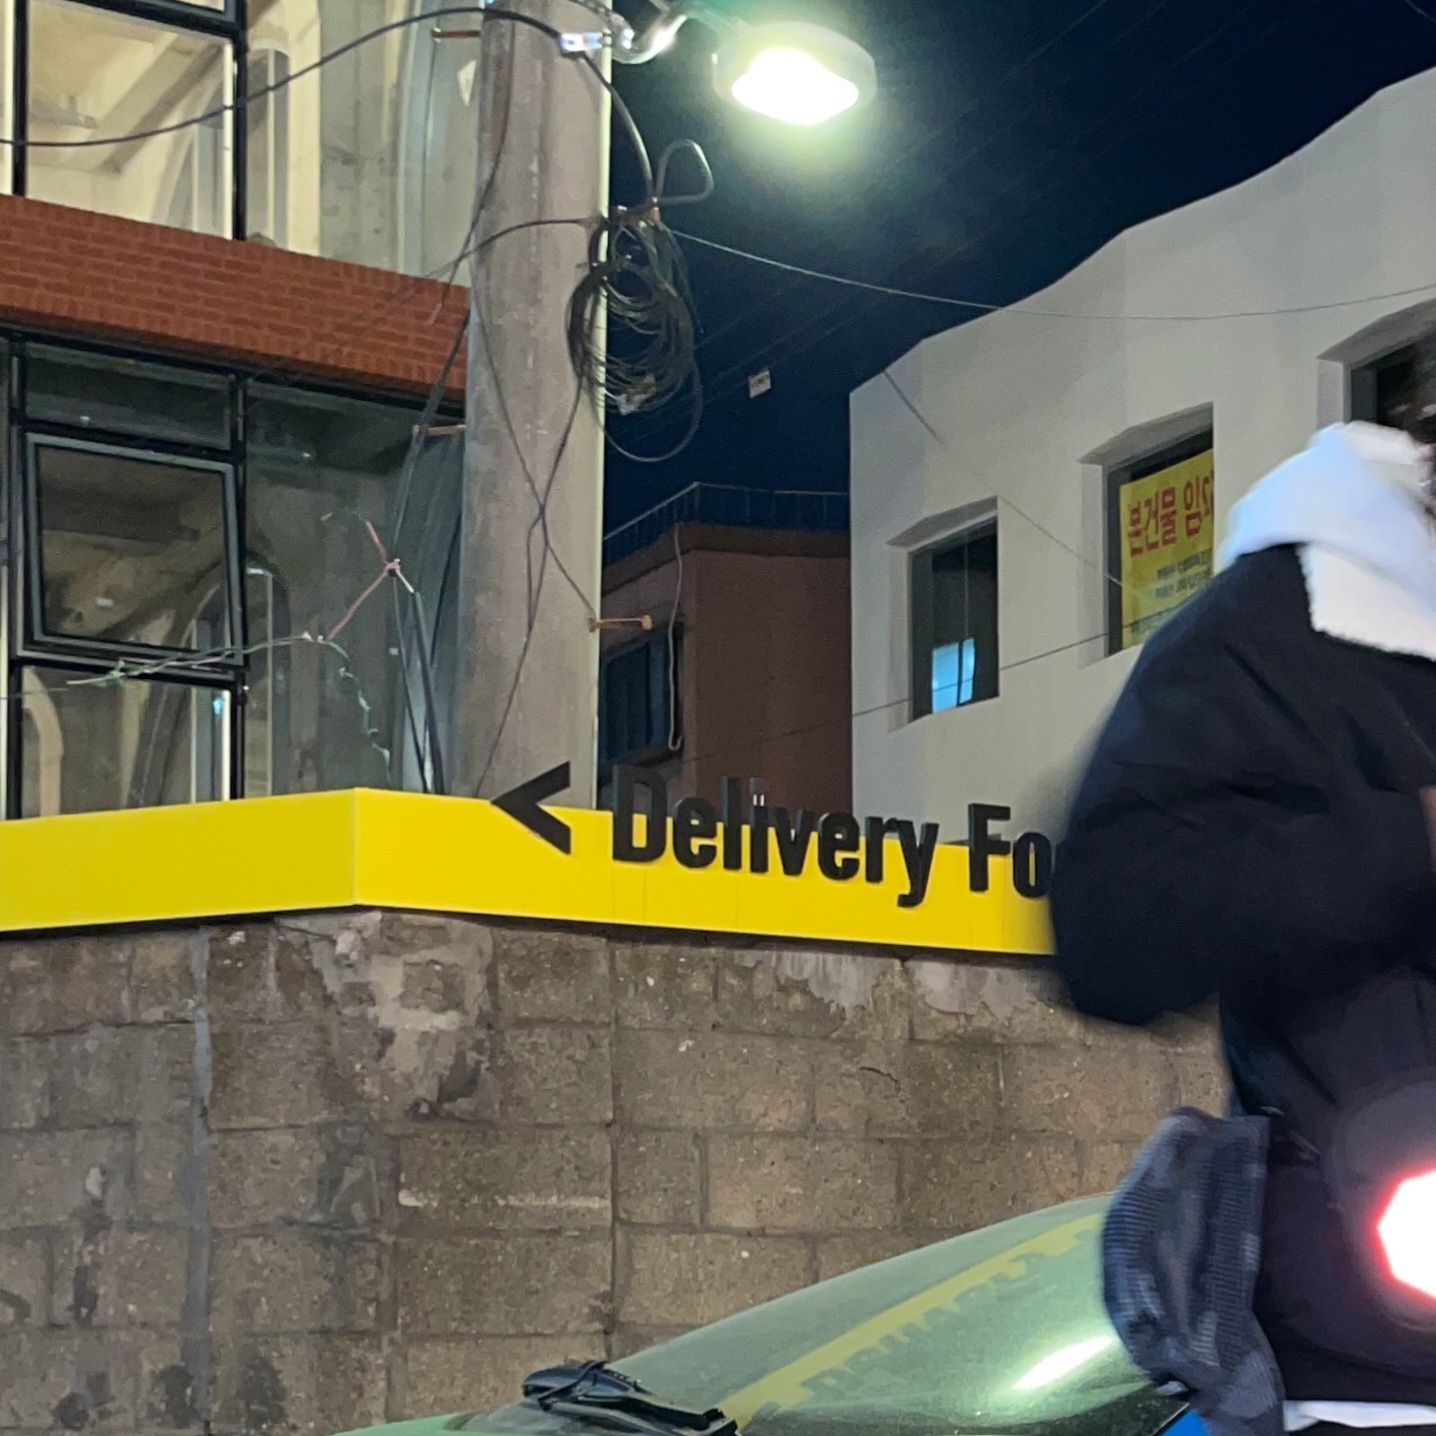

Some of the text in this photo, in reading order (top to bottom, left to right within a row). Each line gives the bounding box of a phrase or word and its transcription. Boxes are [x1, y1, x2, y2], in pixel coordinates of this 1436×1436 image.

[1127, 487, 1177, 558] 본건물
[612, 764, 1053, 908] Delivery Fo
